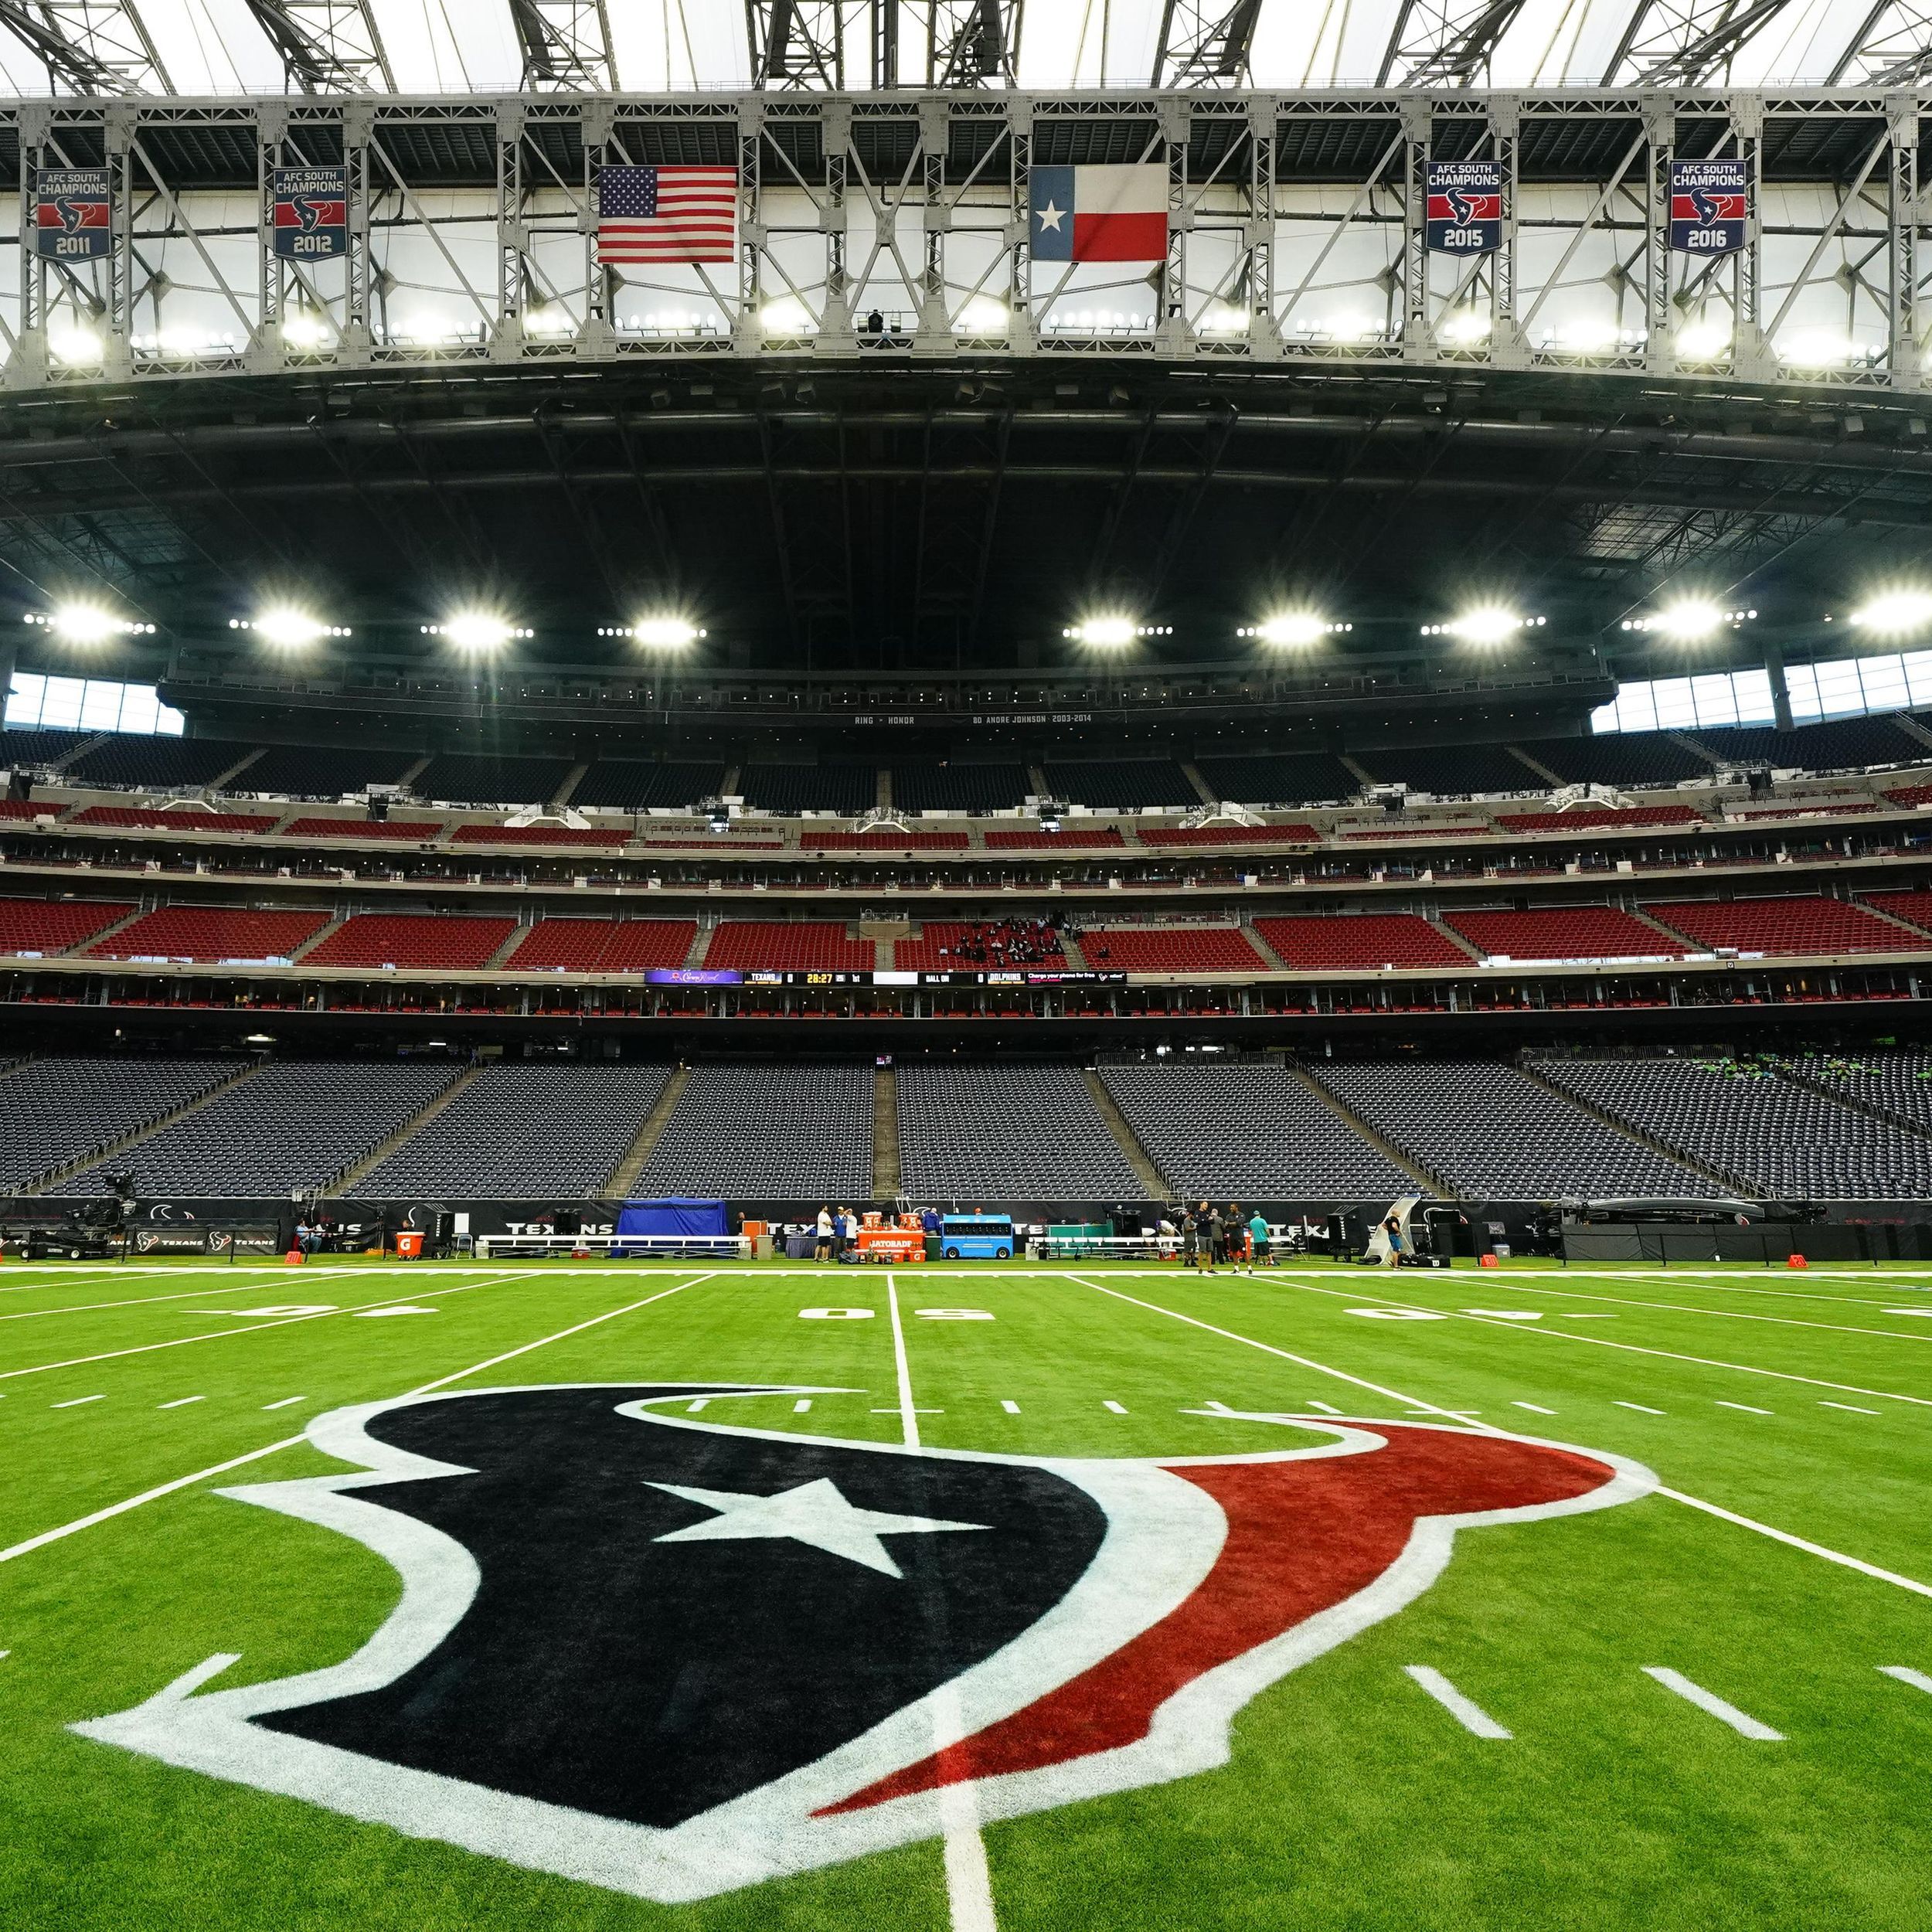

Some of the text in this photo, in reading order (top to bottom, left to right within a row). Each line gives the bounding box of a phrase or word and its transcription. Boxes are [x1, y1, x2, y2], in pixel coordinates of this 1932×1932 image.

[1437, 165, 1492, 174] AFC SOUTH
[1681, 165, 1736, 174] AFC SOUTH
[46, 173, 100, 183] AFC SOUTH
[284, 172, 337, 182] AFC SOUTH
[1428, 174, 1499, 185] CHAMPIONS
[1673, 175, 1744, 186] CHAMPIONS
[39, 183, 107, 195] CHAMPIONS
[276, 181, 344, 193] CHAMPIONS
[1444, 229, 1483, 247] 2015
[1687, 230, 1727, 247] 2016
[56, 236, 90, 254] 2011
[294, 235, 332, 253] 2012
[888, 716, 914, 725] HONOR
[1012, 715, 1046, 723] JOHNSON
[1052, 714, 1091, 723] 2003-2014
[751, 973, 776, 981] TEXANS
[807, 974, 833, 984] 28:27
[989, 973, 1021, 981] DOLPHINS
[505, 1223, 614, 1235] TEXNS
[400, 1237, 411, 1250] G
[287, 1252, 299, 1263] 30
